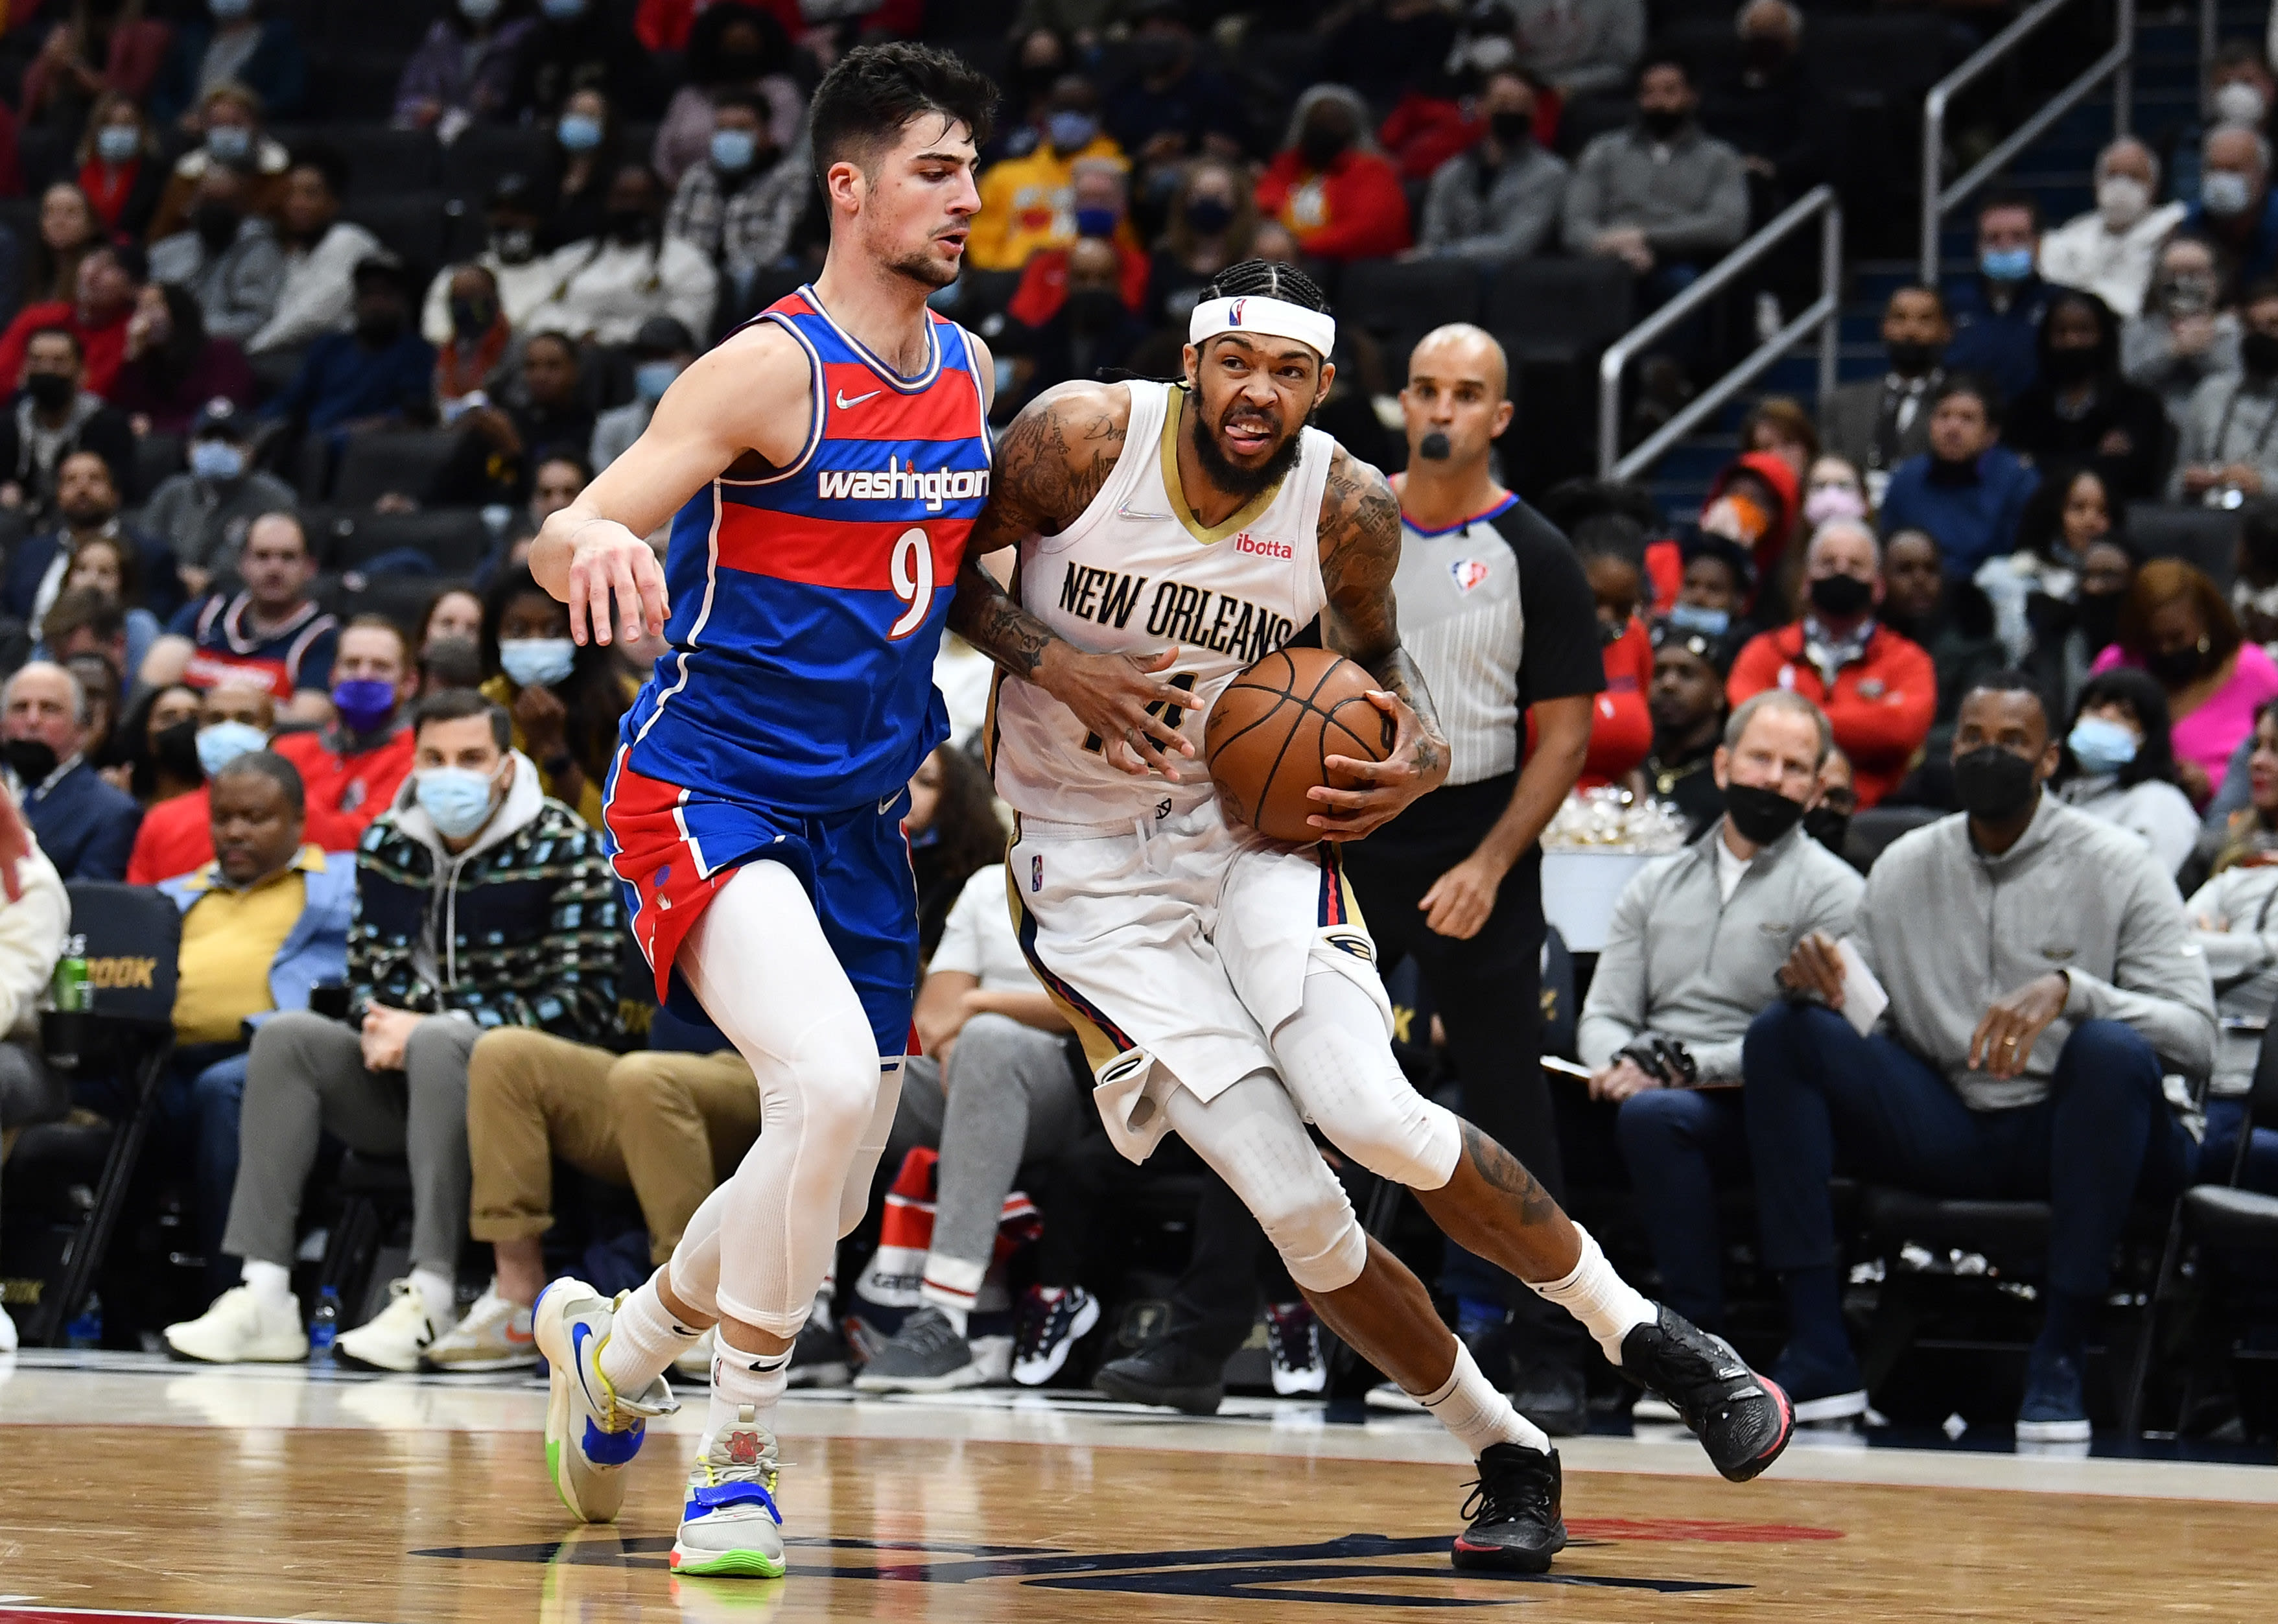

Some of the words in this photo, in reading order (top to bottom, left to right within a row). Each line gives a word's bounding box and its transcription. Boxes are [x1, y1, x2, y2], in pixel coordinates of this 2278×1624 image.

[818, 454, 990, 512] washington
[886, 524, 935, 641] 9
[1236, 533, 1292, 559] ibotta
[1059, 560, 1149, 630] NEW
[1146, 581, 1293, 664] ORLEANS
